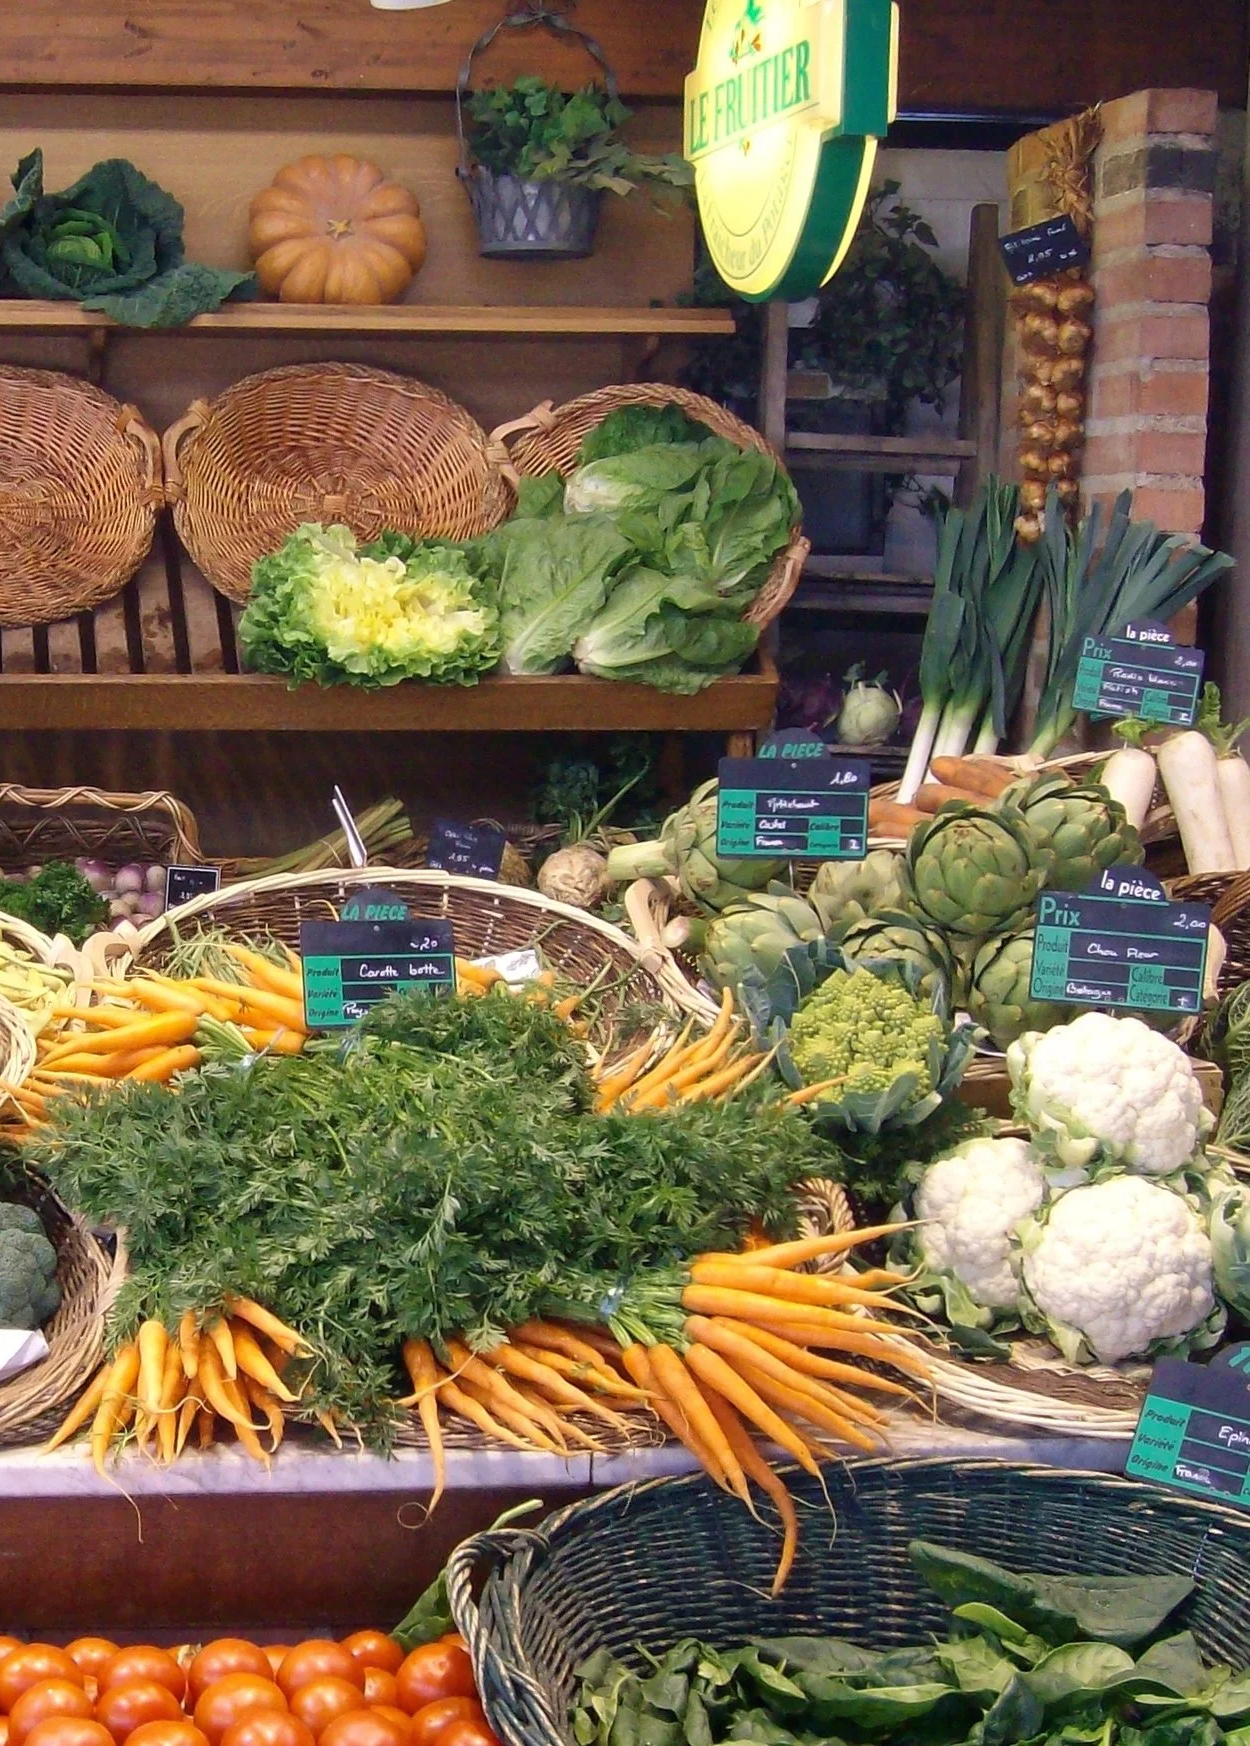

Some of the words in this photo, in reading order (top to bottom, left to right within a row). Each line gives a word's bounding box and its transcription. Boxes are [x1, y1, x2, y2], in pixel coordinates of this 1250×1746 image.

[689, 91, 709, 152] LE
[713, 39, 811, 142] FRUITIER
[1126, 625, 1136, 639] la
[1139, 628, 1171, 643] pièce
[1083, 637, 1113, 660] Prix
[758, 744, 777, 759] LA
[781, 743, 824, 759] PIECE
[1101, 869, 1114, 889] la
[1118, 880, 1162, 901] pièce
[342, 906, 360, 921] LA
[365, 905, 408, 921] PIECE
[1040, 897, 1082, 927] Prix
[1173, 913, 1207, 930] 2,00
[1037, 933, 1068, 954] Produit
[1087, 943, 1119, 957] Chou
[1126, 948, 1159, 959] Fleur
[306, 967, 339, 977] Produit
[409, 962, 445, 975] botte
[1131, 966, 1164, 986] Calibre
[307, 988, 338, 999] Variété
[308, 1007, 339, 1019] Origine
[1145, 1409, 1186, 1428] Produit
[1218, 1425, 1250, 1447] Epin
[1137, 1432, 1176, 1452] Variété
[1130, 1453, 1169, 1473] Origine
